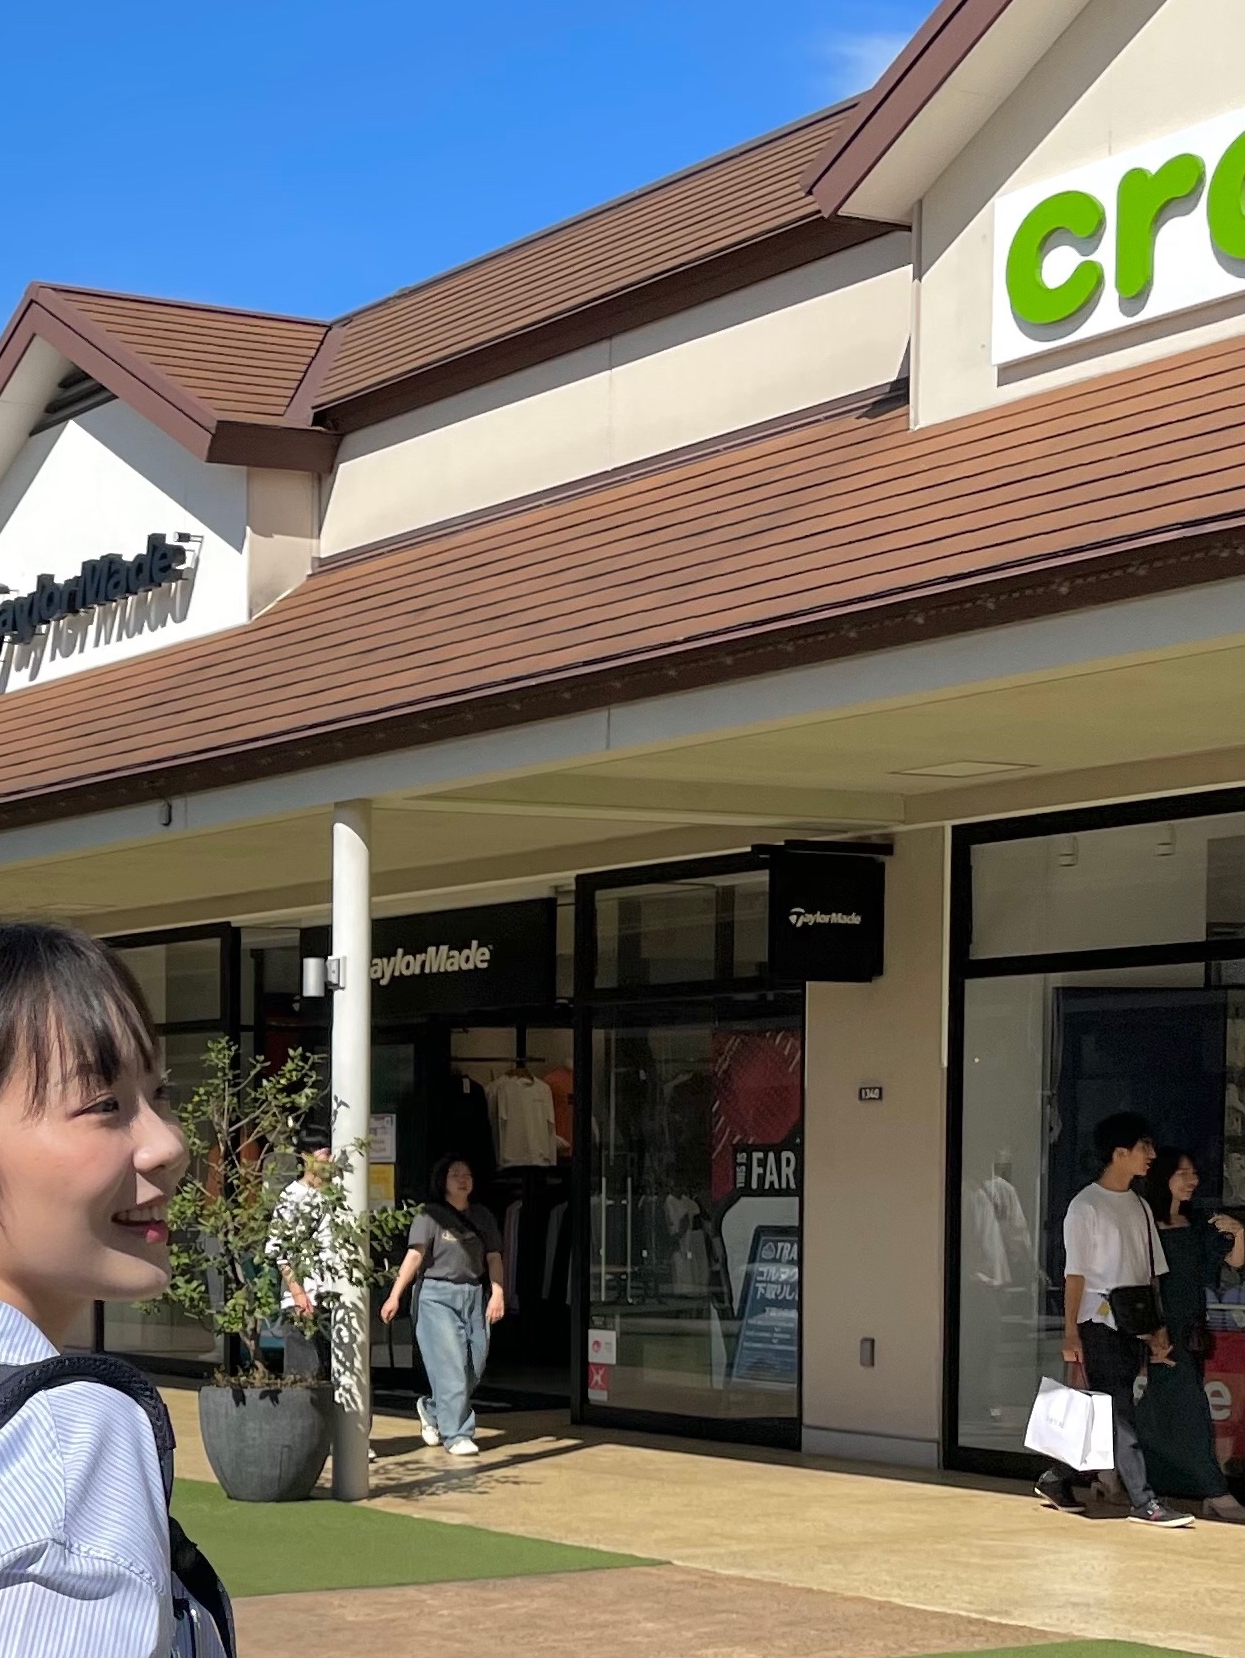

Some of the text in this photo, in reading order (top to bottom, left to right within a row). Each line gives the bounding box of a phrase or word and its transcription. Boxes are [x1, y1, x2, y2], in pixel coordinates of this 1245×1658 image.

[789, 907, 861, 927] TaylorMade
[369, 940, 490, 985] aylorMade
[751, 1150, 796, 1189] FAR
[755, 1283, 798, 1300] 下取りし
